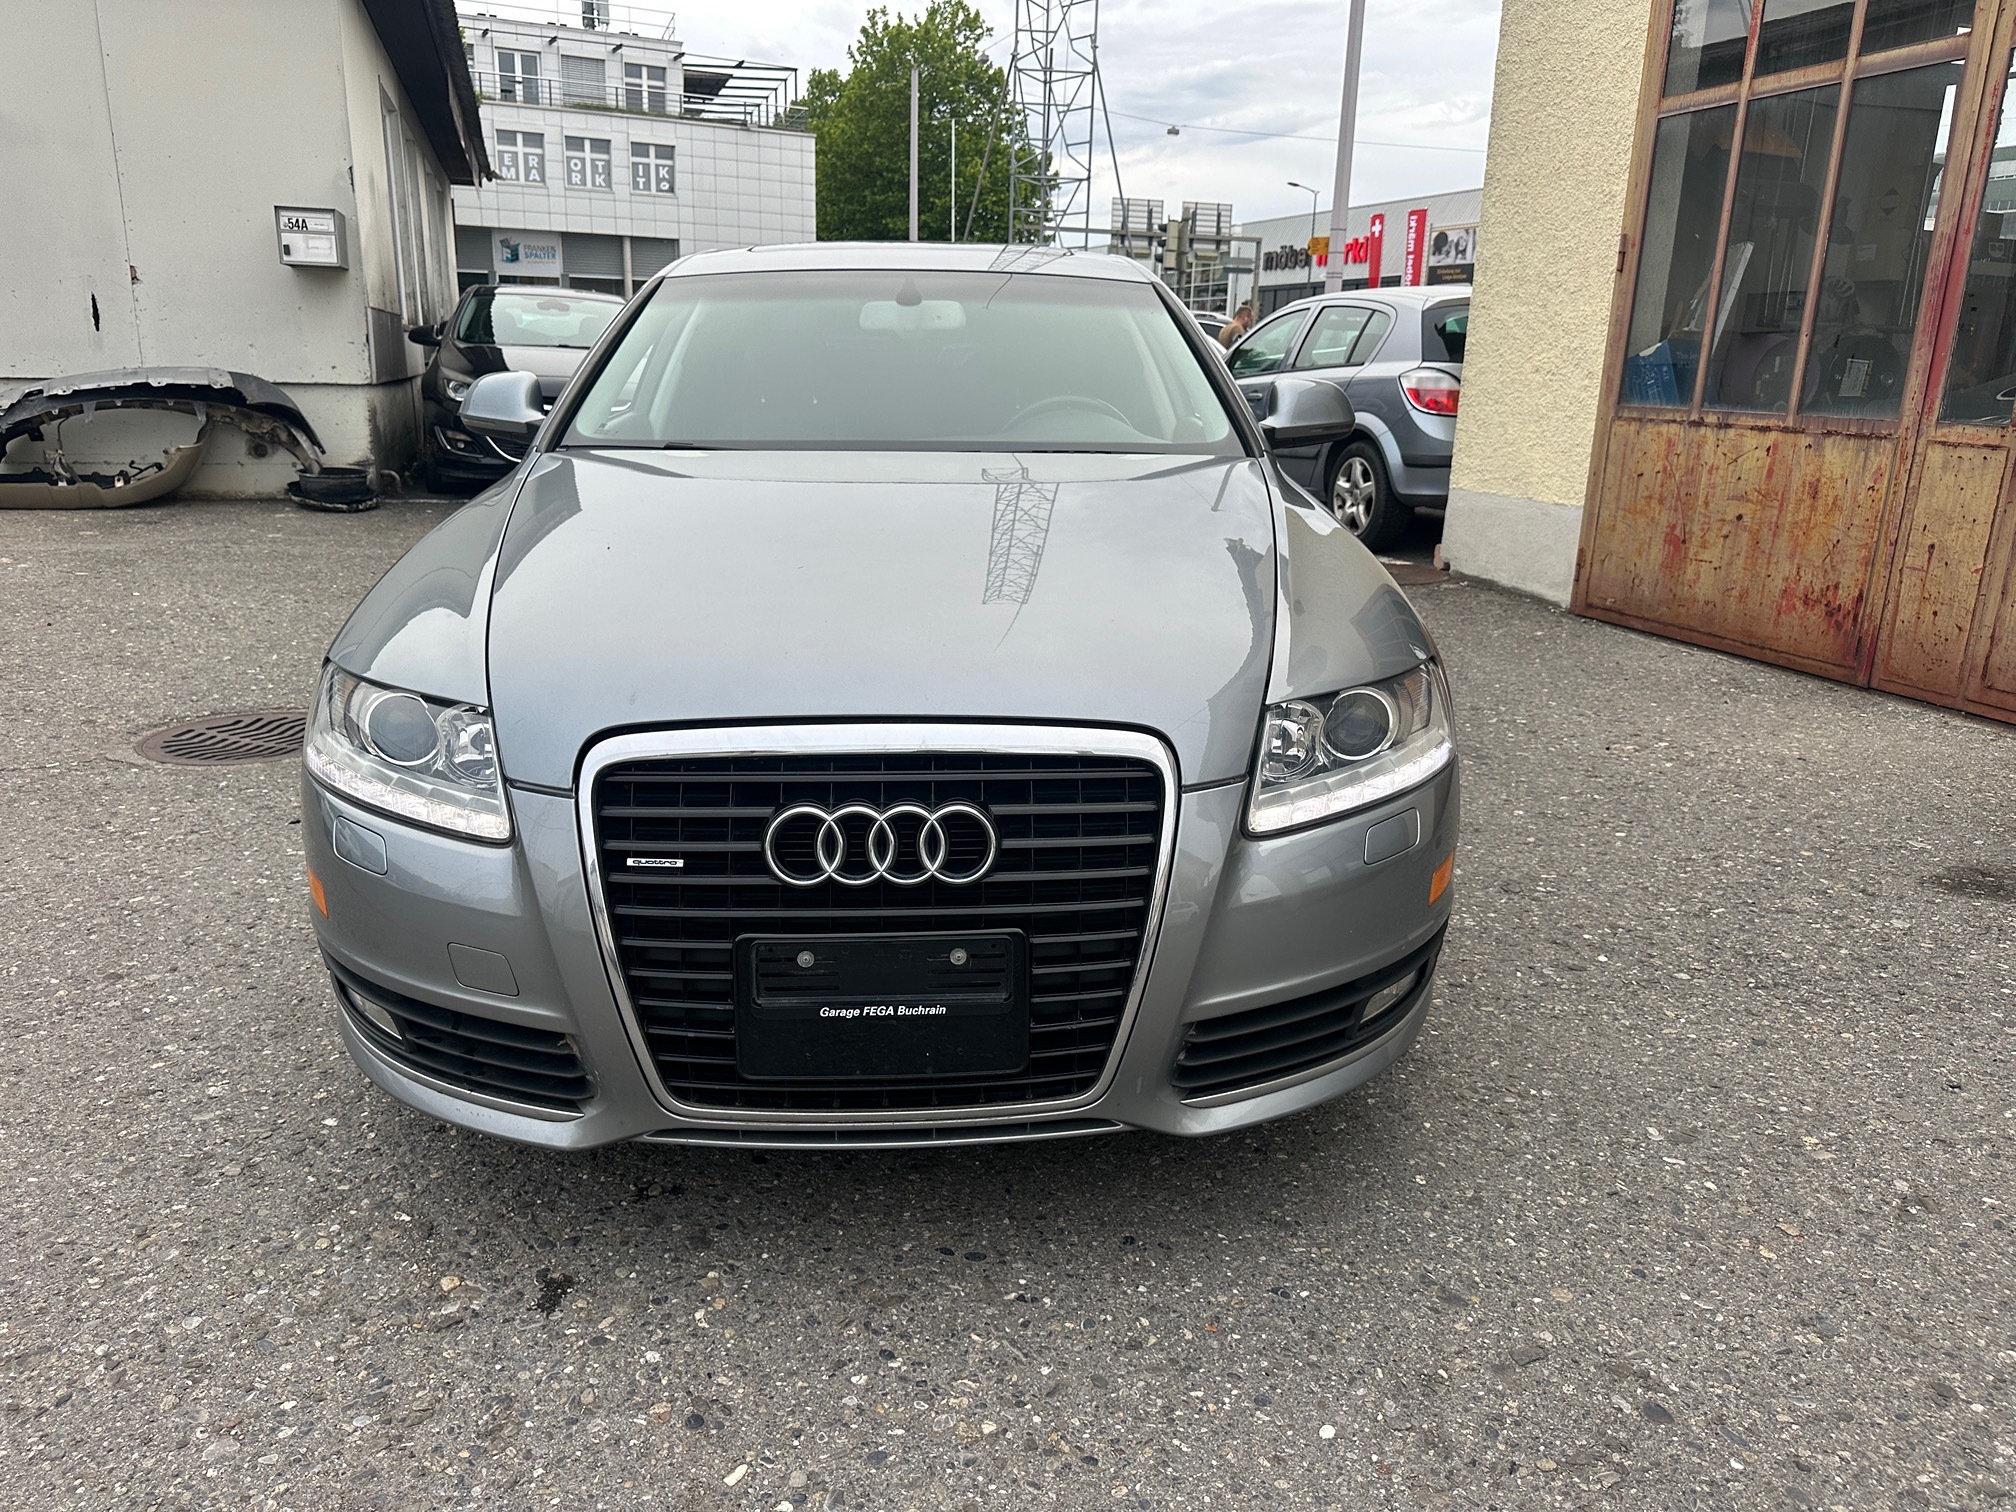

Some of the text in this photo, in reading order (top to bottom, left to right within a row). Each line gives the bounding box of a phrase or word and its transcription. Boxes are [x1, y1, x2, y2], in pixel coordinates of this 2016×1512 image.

[287, 217, 309, 231] 54A
[524, 250, 557, 260] SPALTER
[819, 1004, 947, 1019] Garage FEGA Buchrain
